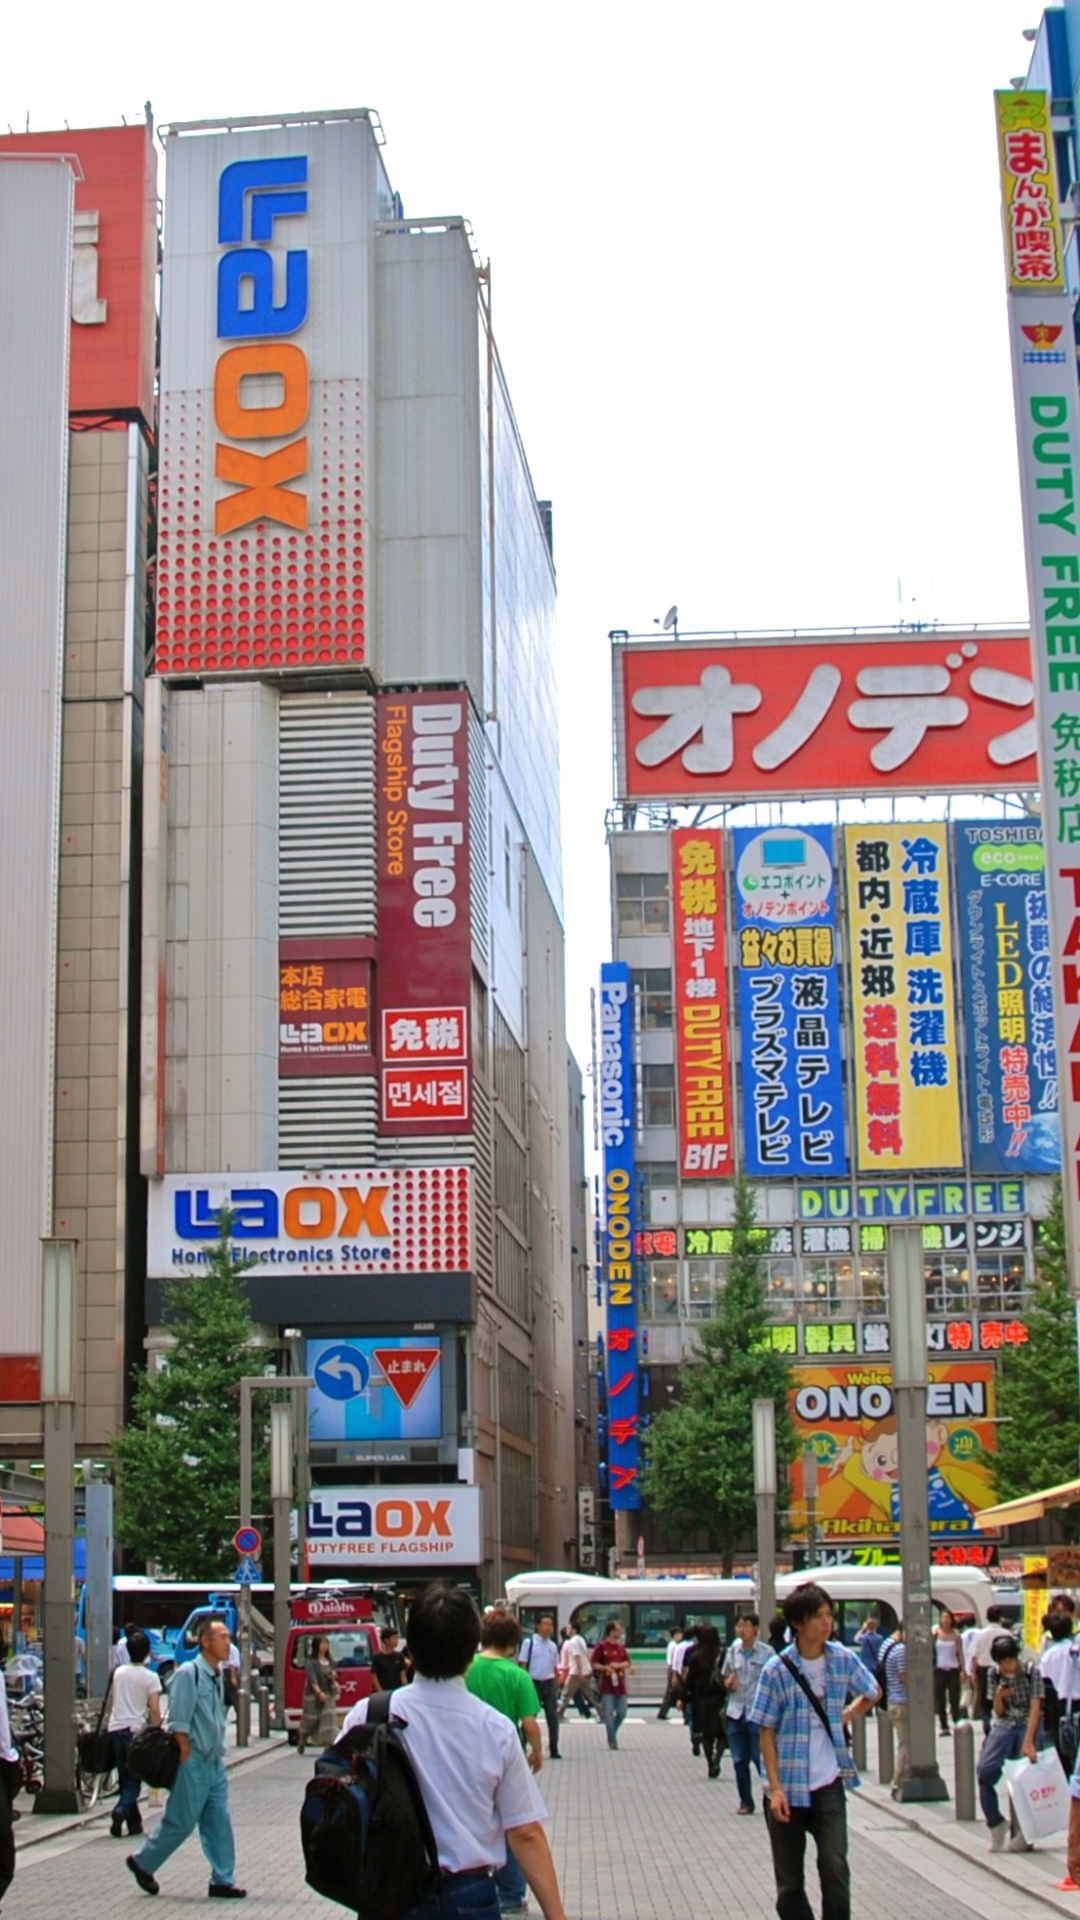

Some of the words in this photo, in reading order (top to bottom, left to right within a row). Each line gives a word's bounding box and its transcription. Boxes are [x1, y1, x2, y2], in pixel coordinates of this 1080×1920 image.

[1006, 131, 1055, 279] まんが喫茶
[1030, 396, 1076, 535] DUTY
[1041, 556, 1080, 693] FREE
[632, 642, 1038, 774] オノデン
[382, 706, 408, 802] Flagship
[407, 704, 462, 811] Duty
[386, 810, 408, 875] Store
[967, 828, 1043, 843] TOSHIB
[412, 822, 463, 928] Free
[679, 840, 717, 915] 免税
[981, 851, 1015, 864] eco
[761, 874, 826, 889] エコポイント
[901, 837, 942, 956] 冷蔵庫
[981, 873, 1041, 887] E-CORE
[742, 900, 830, 918] オノデンポイント
[740, 926, 834, 968] 益々お買得
[281, 965, 324, 987] 本店
[280, 987, 367, 1011] 総合家電
[389, 1017, 460, 1051] 免税
[908, 967, 948, 1087] 洗濯機
[602, 982, 630, 1147] Panasonic
[752, 975, 790, 1163] プラズマテレビ
[794, 976, 834, 1163] 液晶テレビ
[388, 1080, 462, 1107] 면세점
[684, 1143, 729, 1170] B1F
[231, 1246, 334, 1264] Electronics
[341, 1243, 391, 1262] Store
[607, 1168, 633, 1304] ONODEN
[387, 1359, 427, 1374] 止まれ
[607, 1327, 637, 1489] オノデン
[795, 1382, 986, 1420] ONOEN
[822, 1518, 969, 1535] Akihaara
[308, 1542, 376, 1554] UTYFREE
[381, 1542, 454, 1553] FLAGSHIP
[308, 1601, 355, 1614] Daiohs
